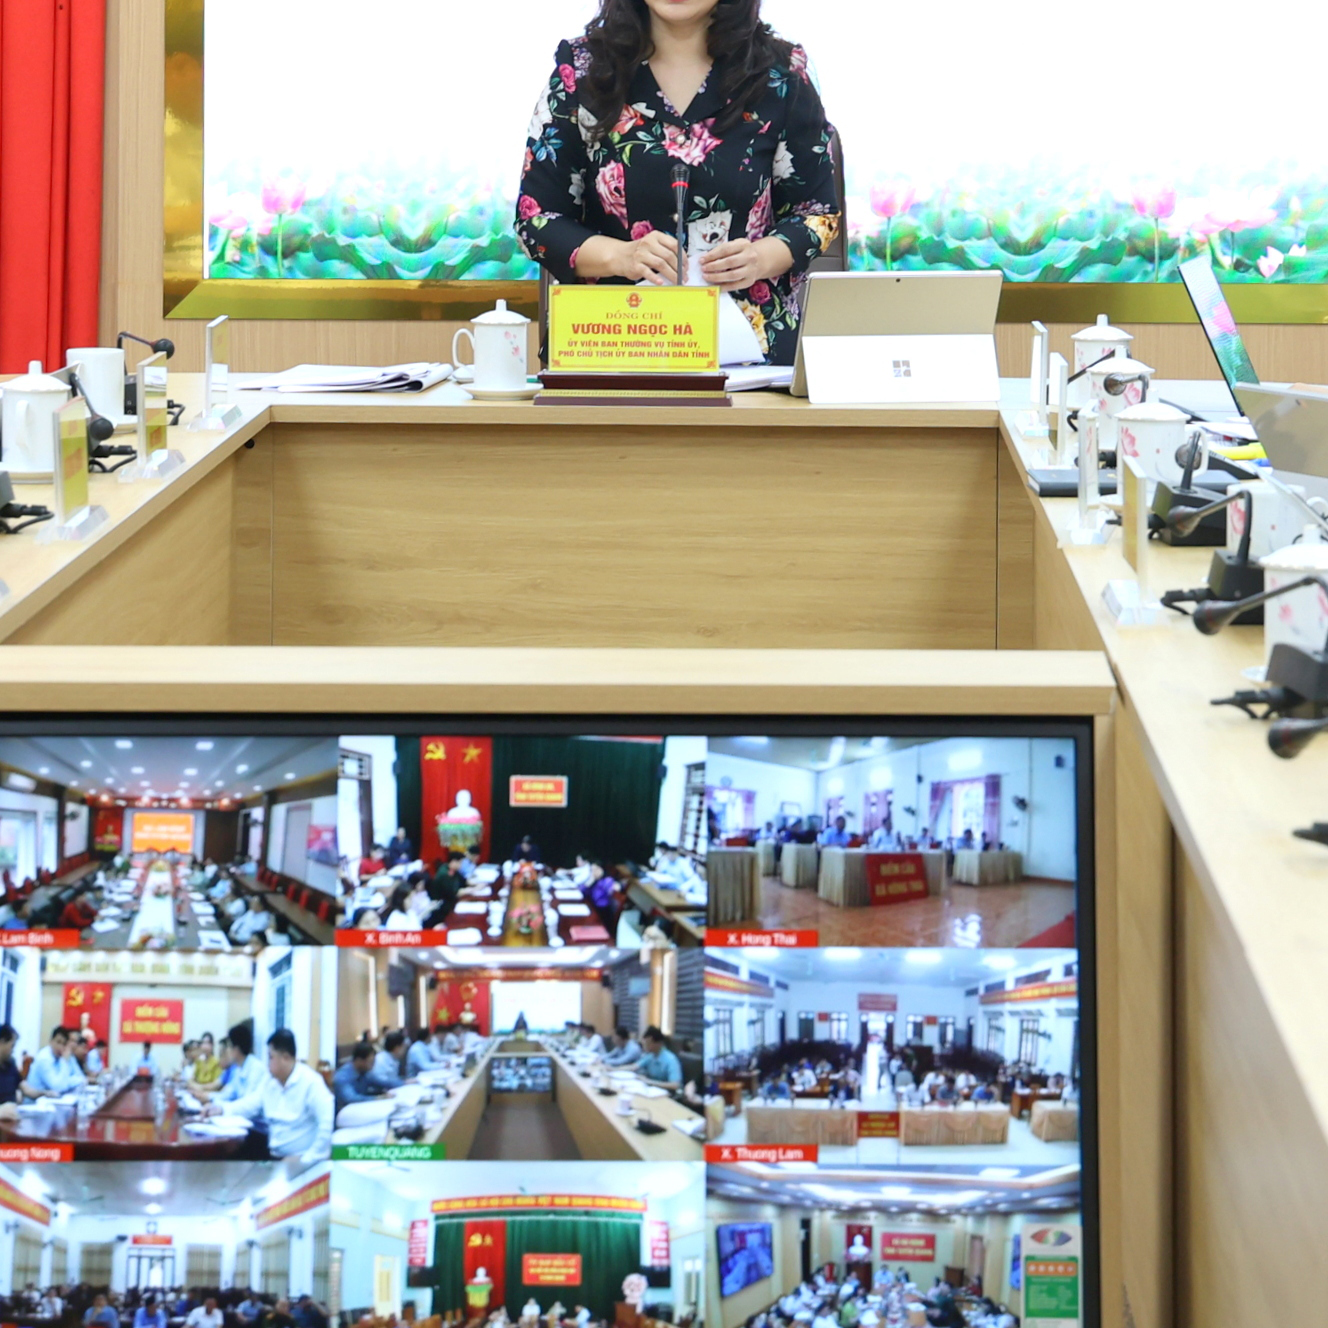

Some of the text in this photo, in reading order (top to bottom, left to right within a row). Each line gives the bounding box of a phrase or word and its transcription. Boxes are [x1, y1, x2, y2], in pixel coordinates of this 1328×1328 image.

[642, 311, 663, 320] CHÍ
[572, 322, 693, 337] VƯƠNG NGỌC HÀ
[580, 340, 599, 348] VIÊN
[654, 341, 665, 349] VỤ
[667, 339, 686, 348] TỈNH
[558, 348, 575, 358] PHÓ
[576, 349, 594, 358] CHỦ
[596, 351, 614, 359] TỊCH
[627, 351, 645, 359] BAN
[647, 350, 670, 358] NHÂN
[672, 350, 690, 359] DÂN
[691, 349, 710, 359] TỈNH
[27, 932, 54, 945] Binh
[727, 933, 740, 945] X.
[740, 933, 772, 946] Hong
[735, 1147, 777, 1162] Thuong
[777, 1147, 804, 1159] Lam
